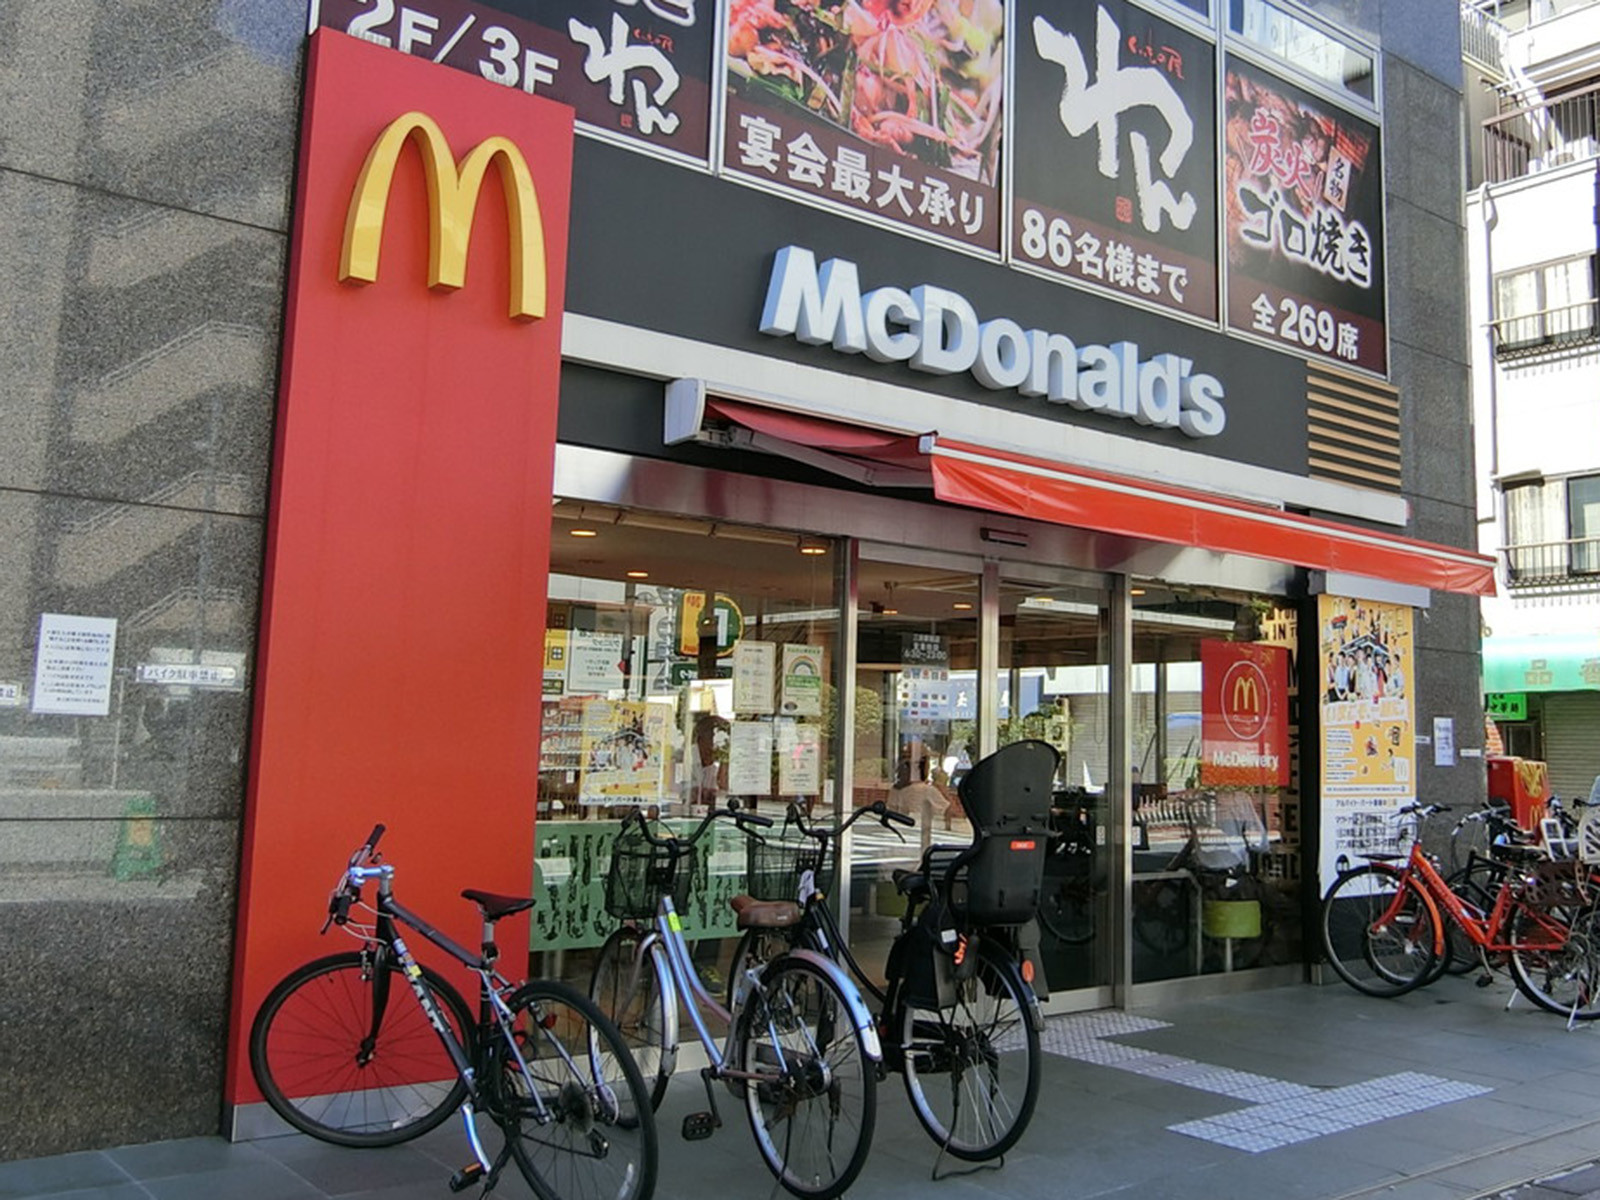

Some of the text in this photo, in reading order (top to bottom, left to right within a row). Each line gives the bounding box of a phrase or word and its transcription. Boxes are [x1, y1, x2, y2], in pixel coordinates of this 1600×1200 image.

[568, 12, 680, 134] わん
[1033, 4, 1197, 232] わん
[738, 114, 983, 235] 宴会最大承り
[1021, 209, 1188, 304] 86名様まで
[759, 245, 1227, 438] McDonald's
[1251, 293, 1359, 362] 全269席
